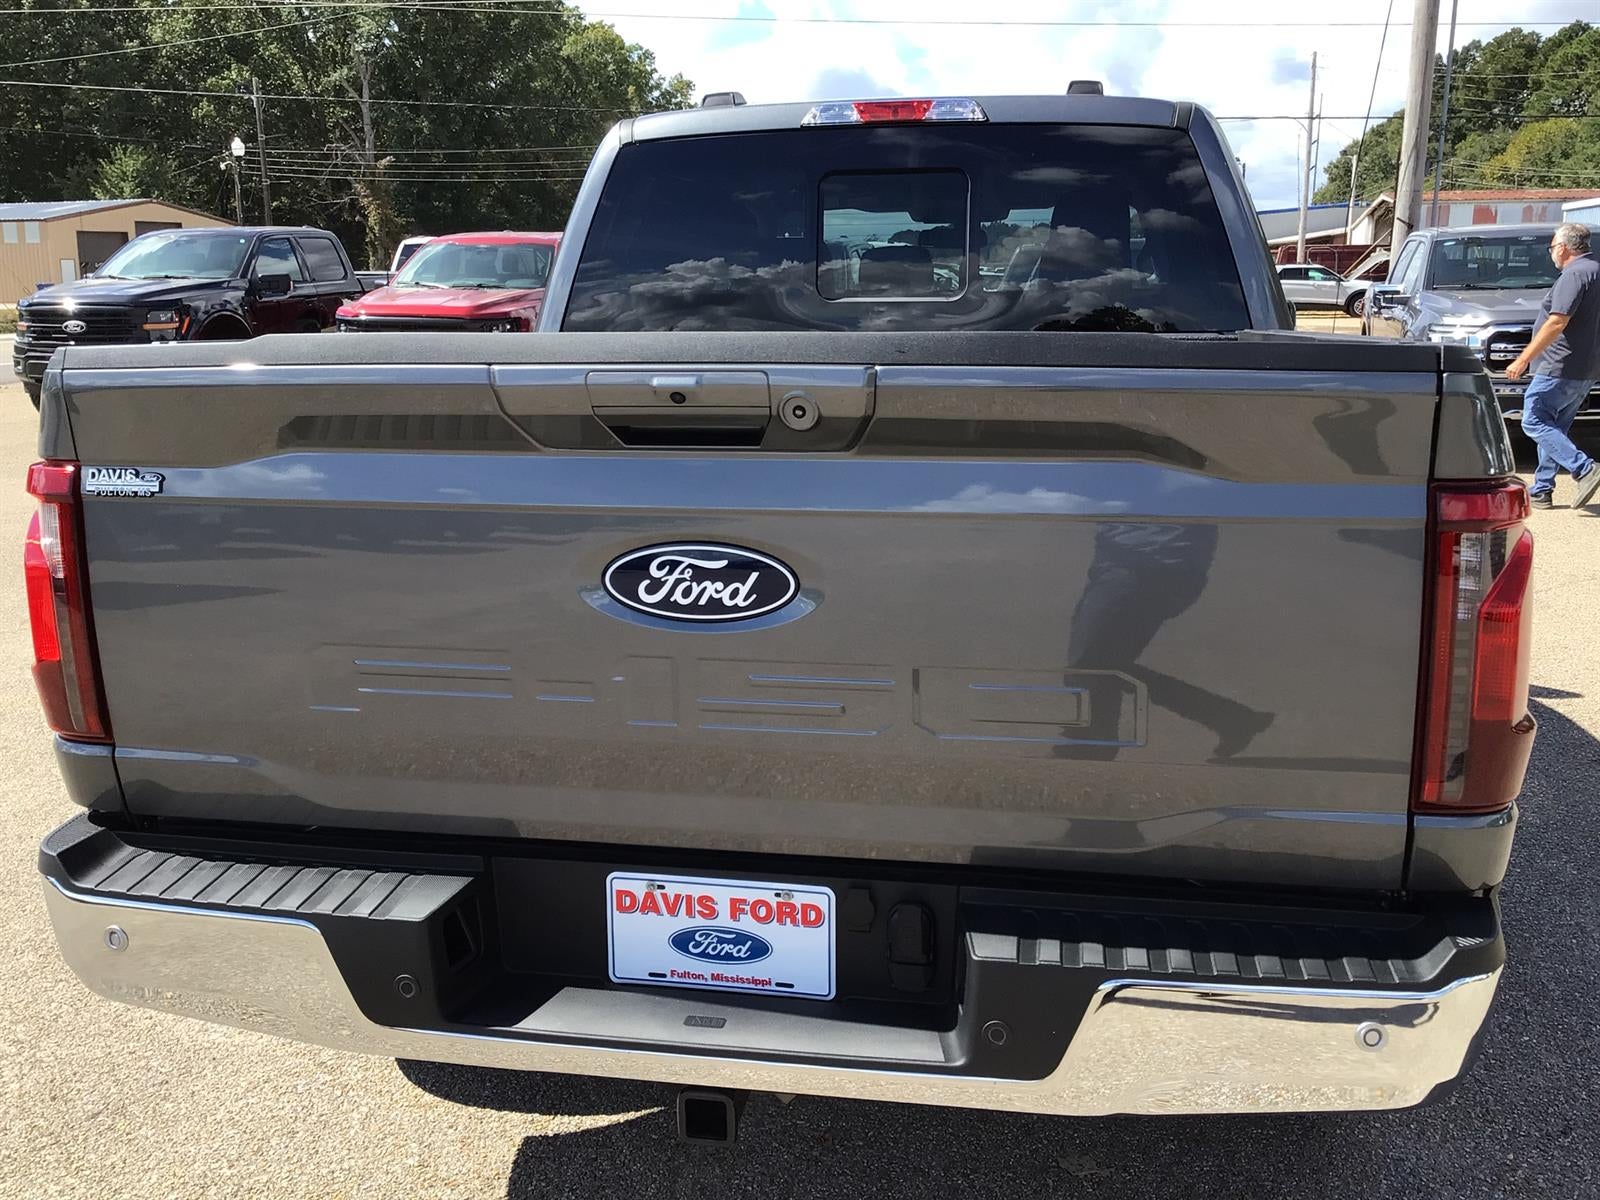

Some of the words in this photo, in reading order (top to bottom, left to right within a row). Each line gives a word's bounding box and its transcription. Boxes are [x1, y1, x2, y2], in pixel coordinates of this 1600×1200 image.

[137, 488, 151, 497] MS
[637, 555, 760, 607] Ford
[299, 642, 1149, 748] F-150
[615, 889, 719, 920] DAVIS
[729, 897, 825, 928] FORD
[688, 930, 752, 958] Ford
[670, 969, 708, 982] Fulton,
[710, 973, 772, 988] Mississippi
